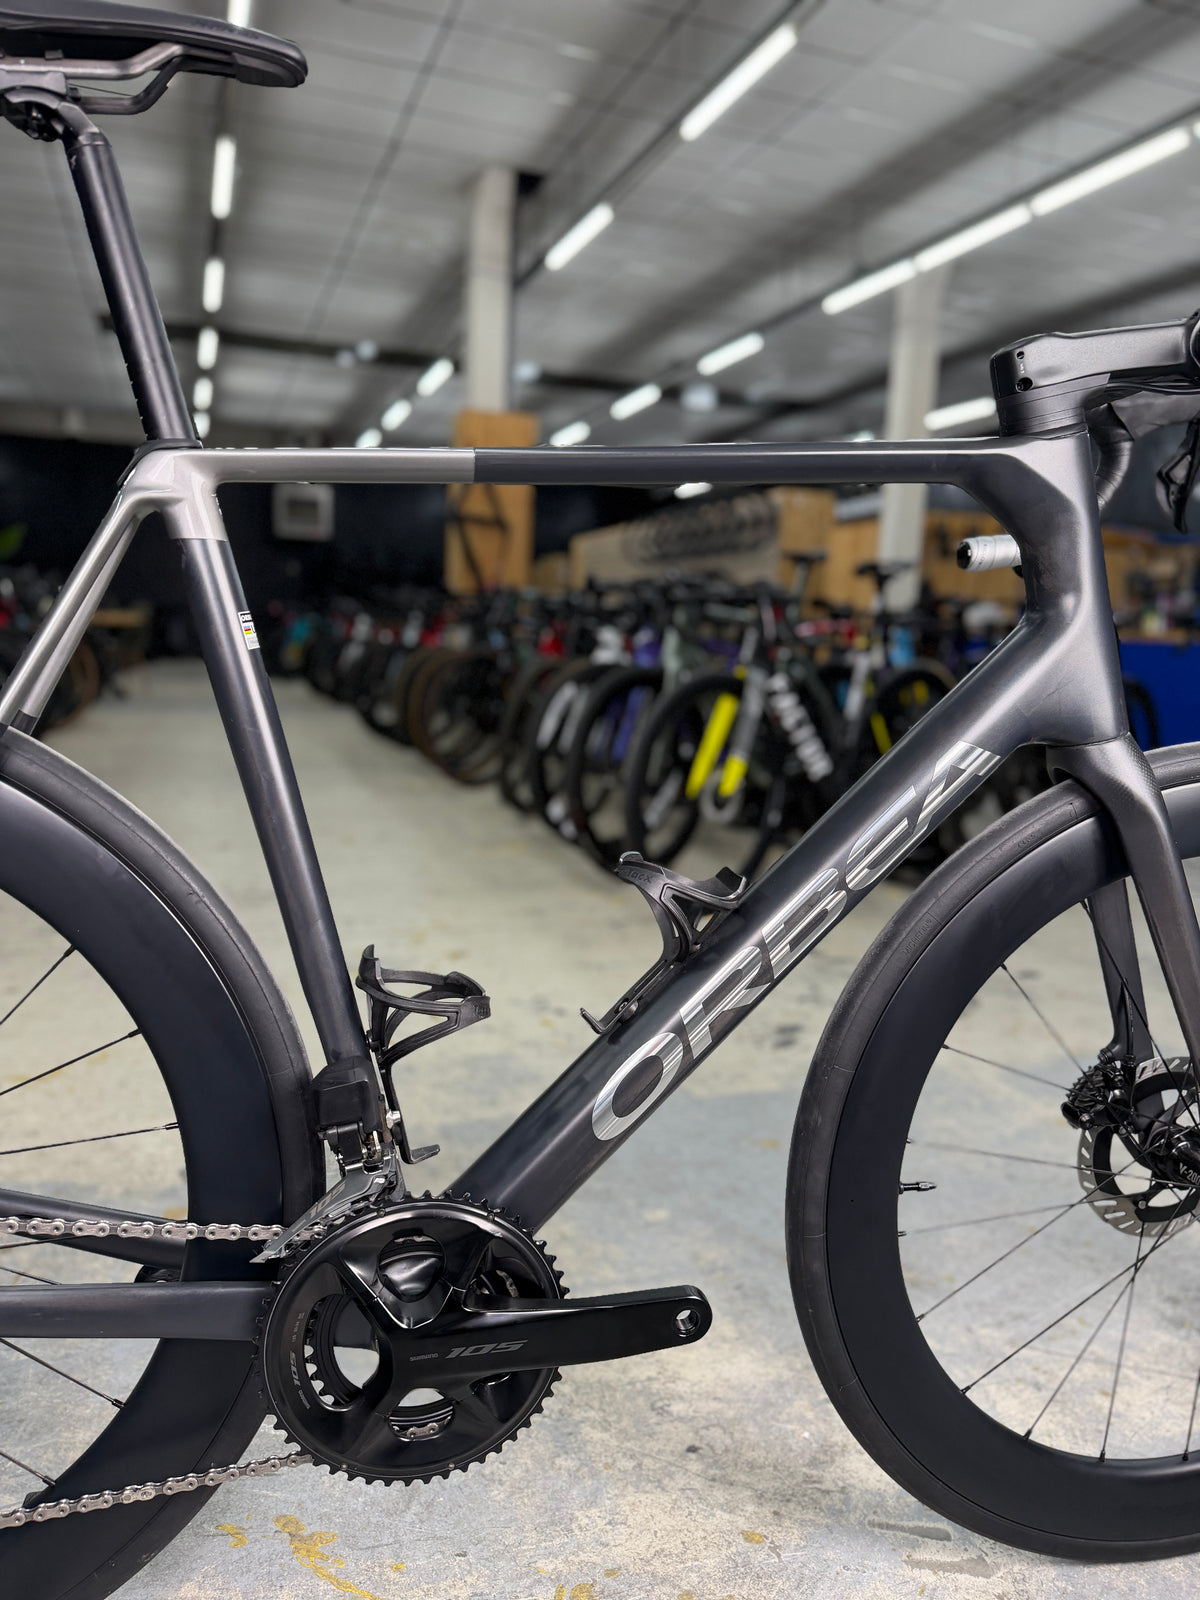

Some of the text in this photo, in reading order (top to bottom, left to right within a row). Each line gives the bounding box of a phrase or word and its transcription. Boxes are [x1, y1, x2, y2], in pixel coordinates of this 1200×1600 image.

[592, 740, 1000, 1140] ORBEA
[310, 1180, 346, 1219] 105
[290, 1350, 301, 1387] 105
[445, 1340, 528, 1359] 105
